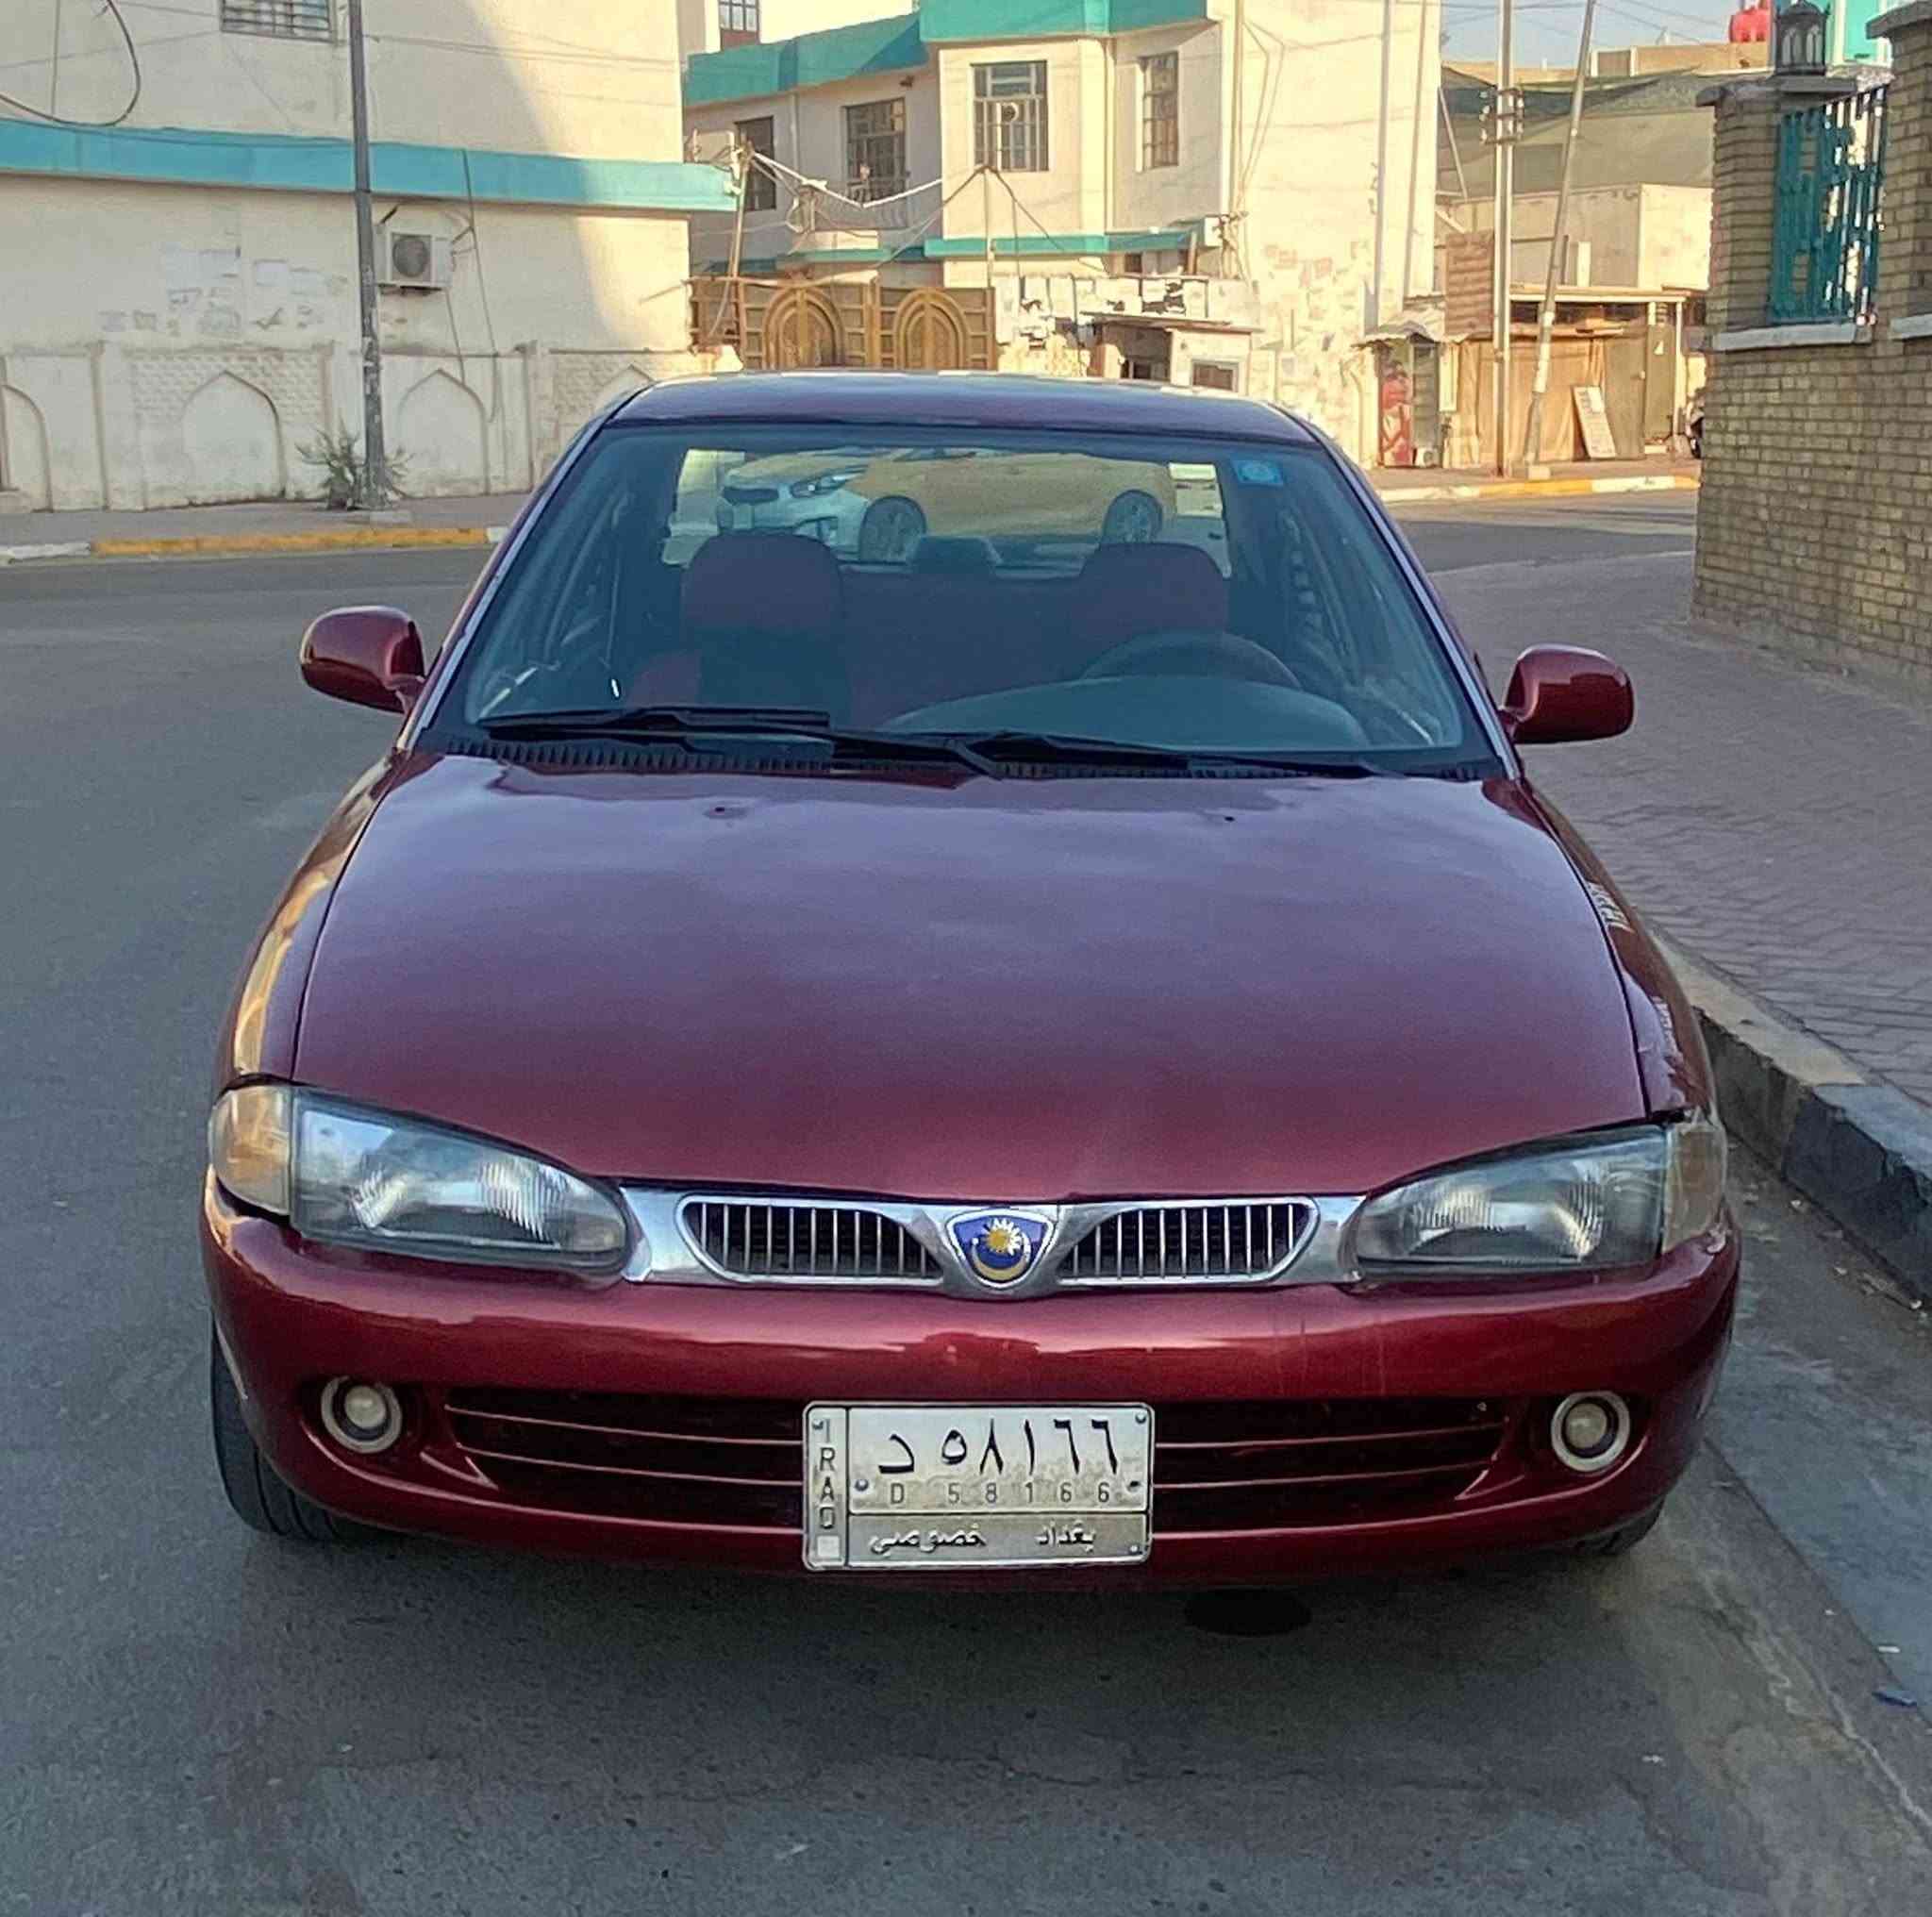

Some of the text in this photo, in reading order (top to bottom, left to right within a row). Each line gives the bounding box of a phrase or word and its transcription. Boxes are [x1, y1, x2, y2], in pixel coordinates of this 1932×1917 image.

[878, 1418, 1118, 1475] د ٥٨١٦٦
[891, 1482, 1110, 1504] D 58166
[870, 1520, 1096, 1558] بغداد خصوصي
